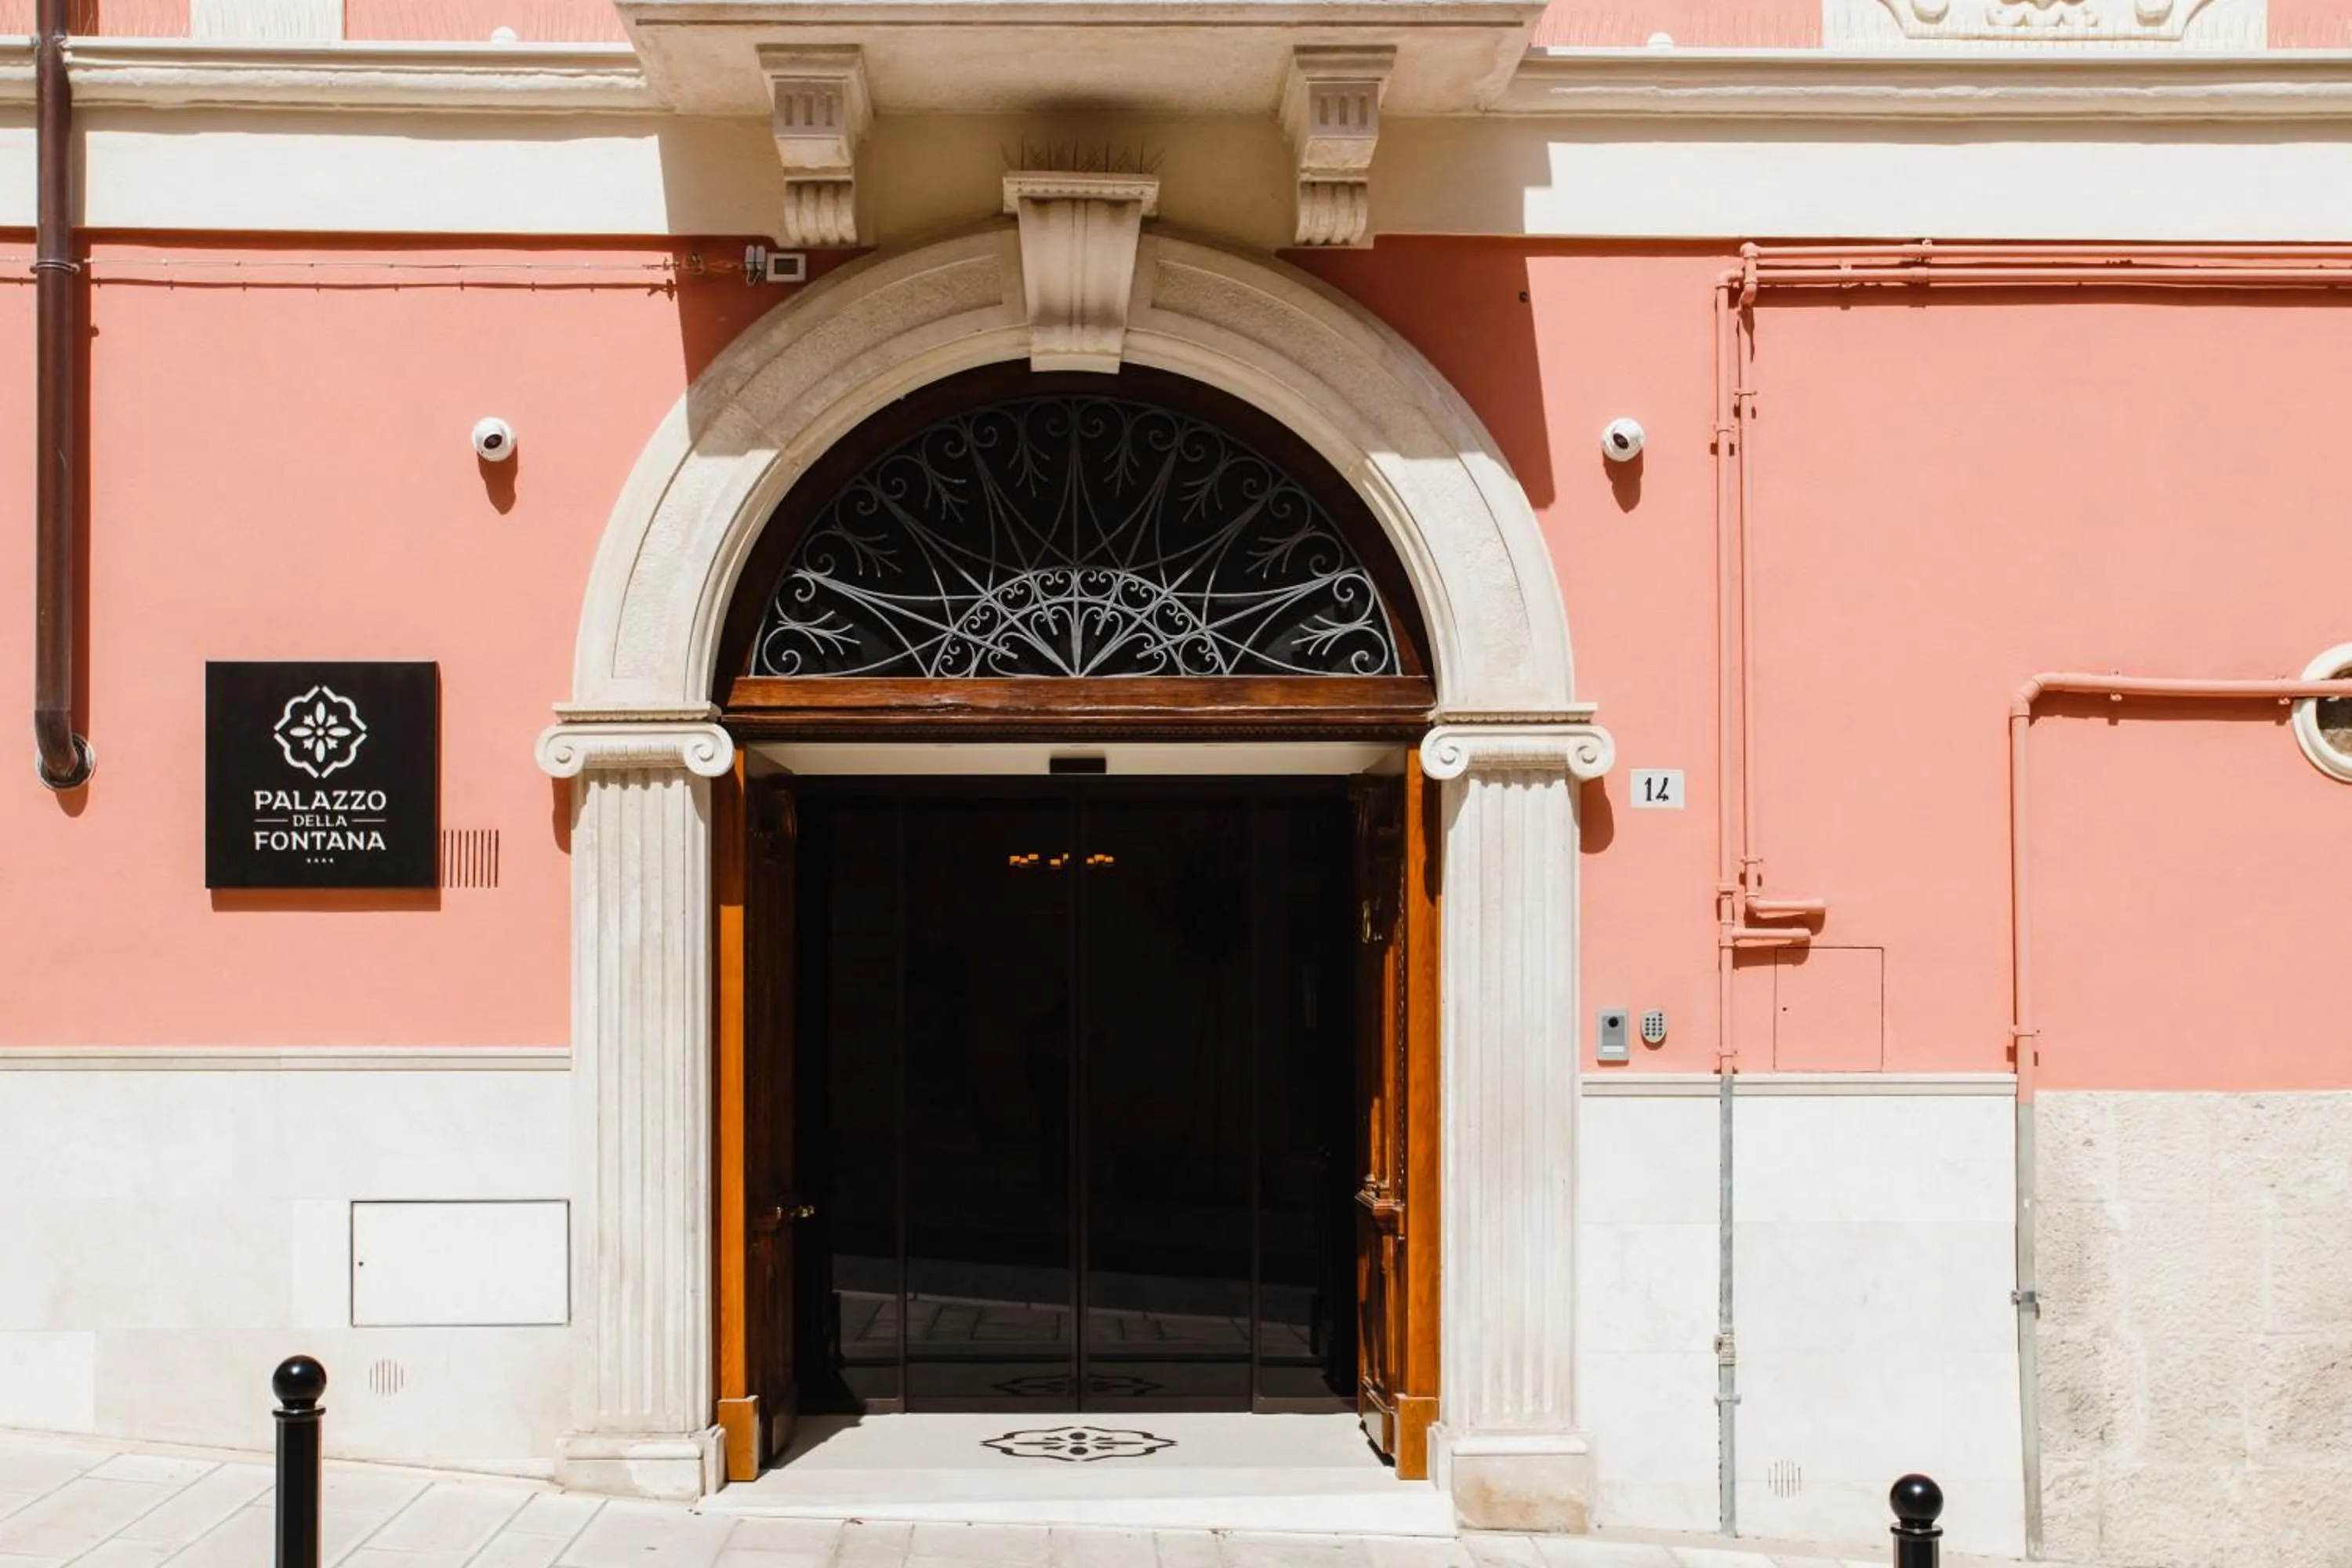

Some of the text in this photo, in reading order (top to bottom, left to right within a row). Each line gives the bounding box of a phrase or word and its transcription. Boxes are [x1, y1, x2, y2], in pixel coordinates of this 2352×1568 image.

[253, 789, 387, 811] PALAZZO
[1643, 777, 1670, 802] 14
[292, 814, 348, 828] DELLA
[253, 830, 387, 851] FONTANA
